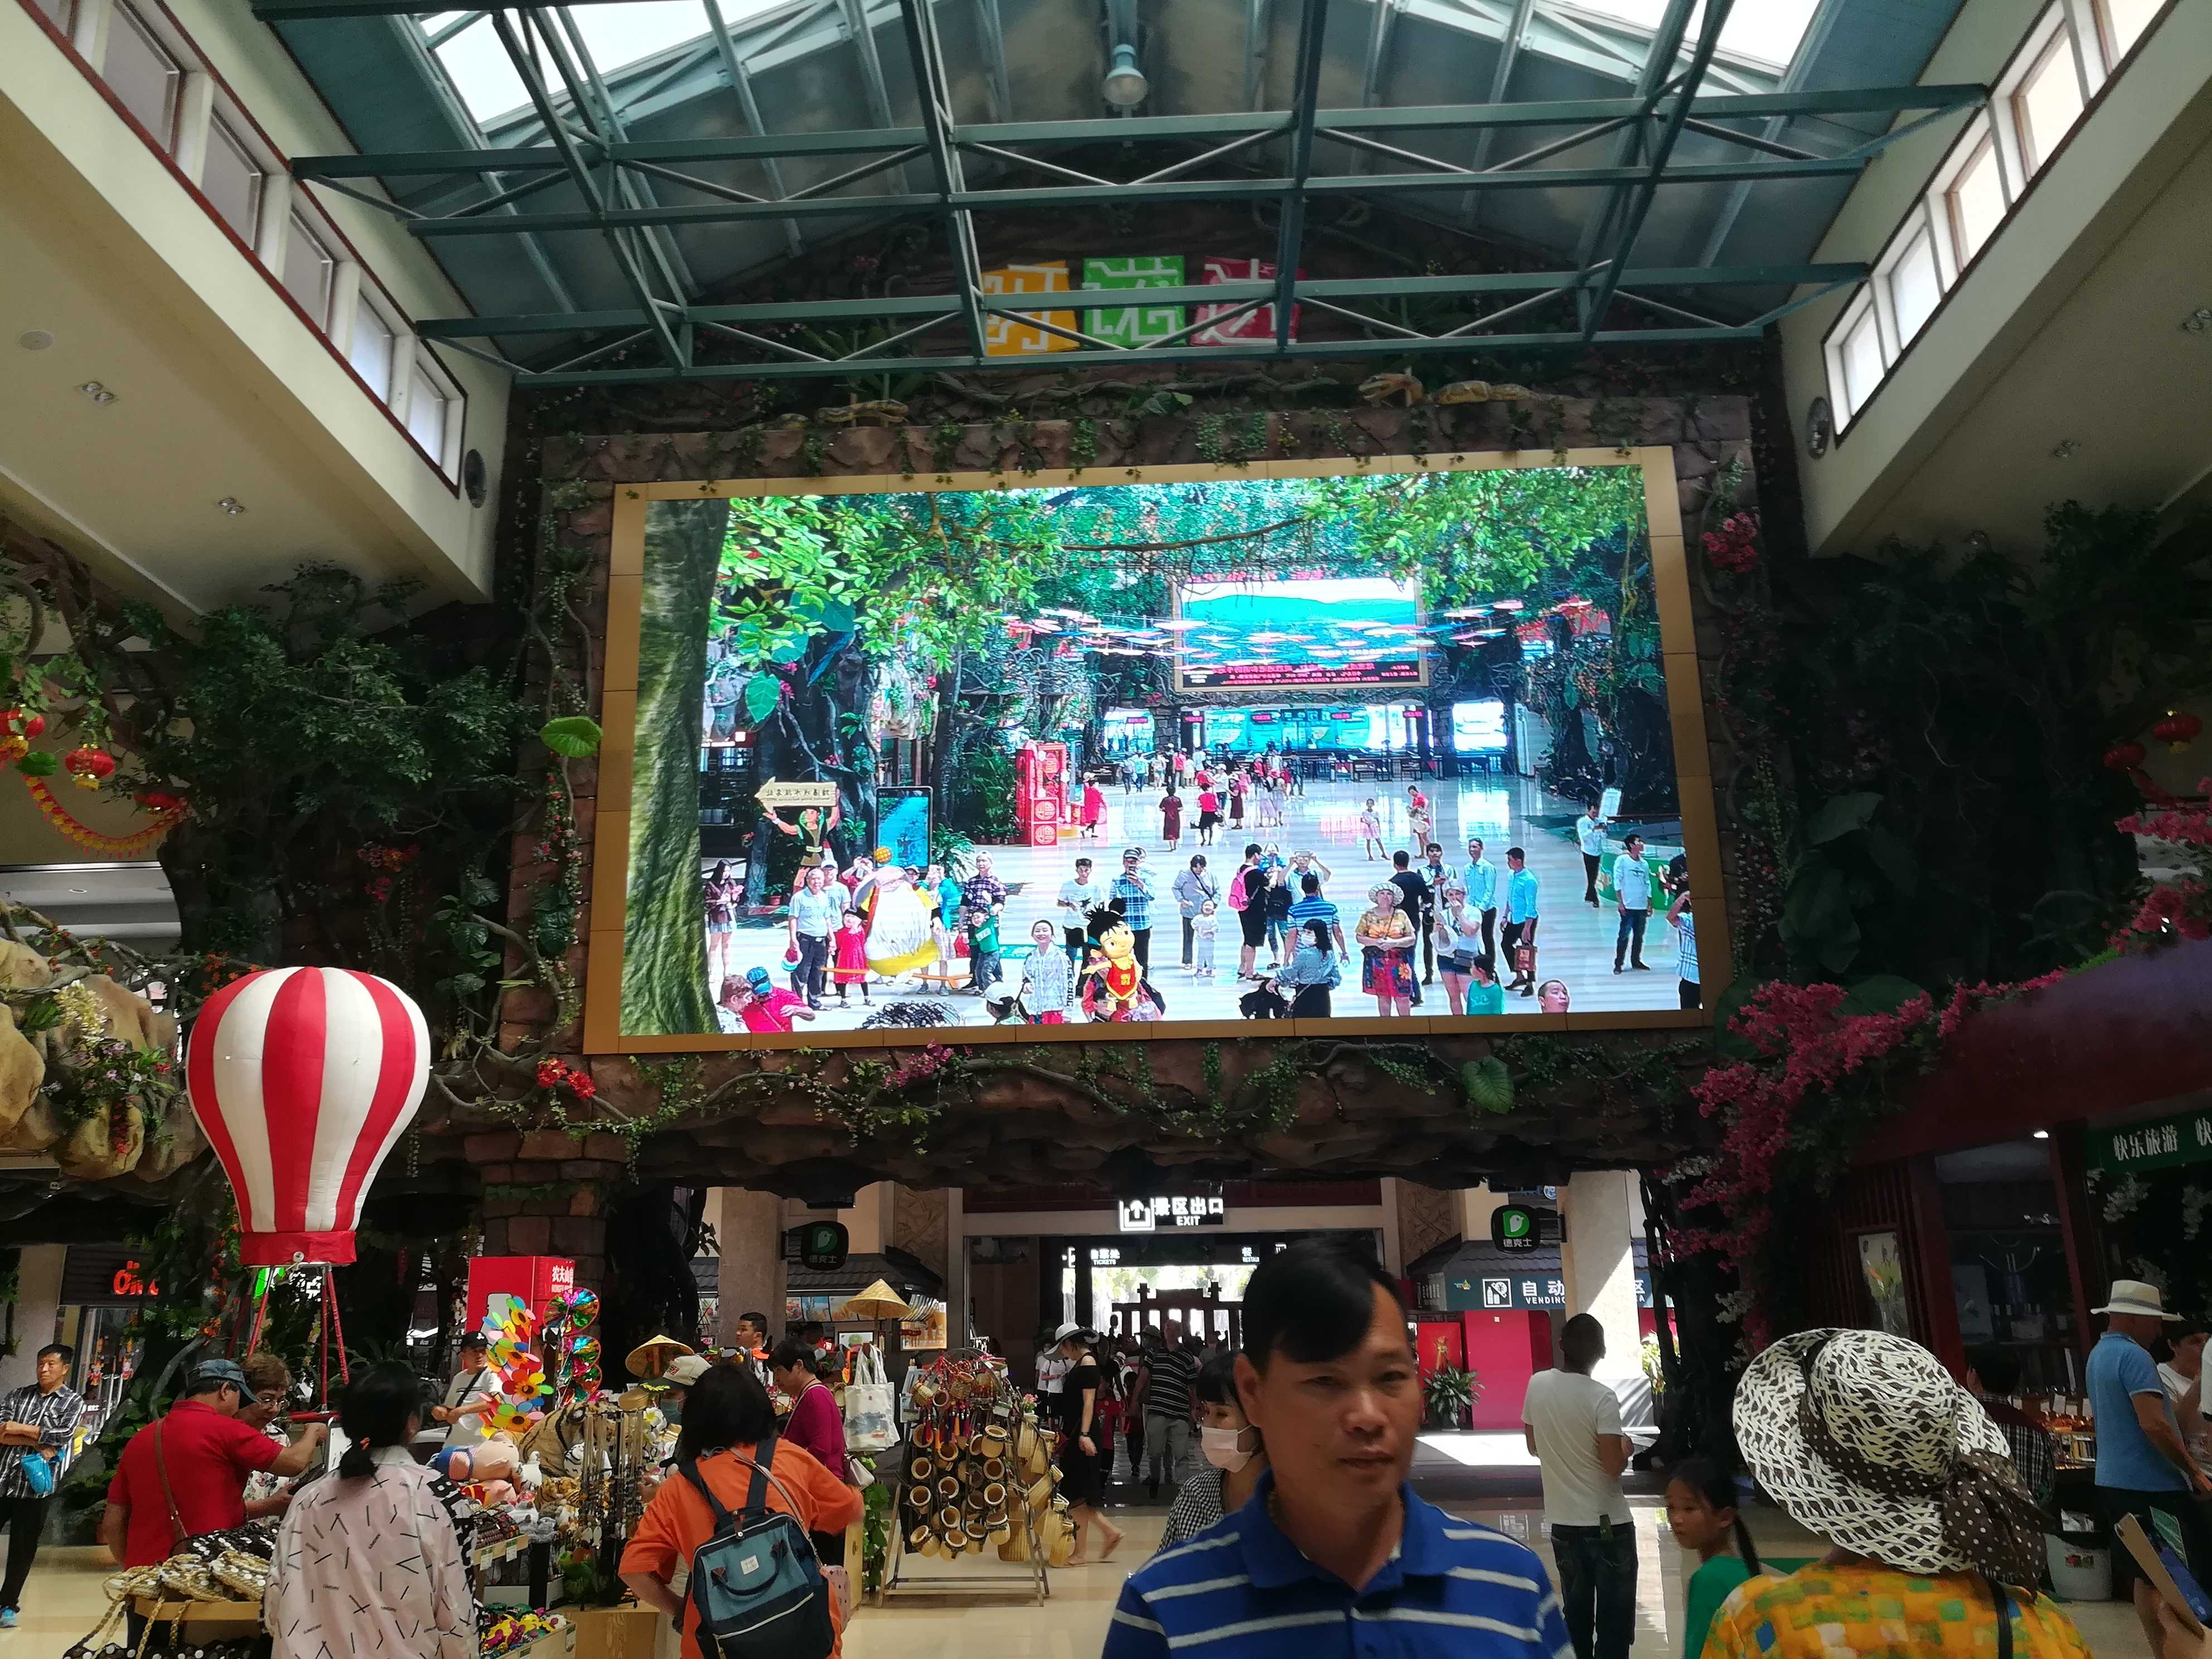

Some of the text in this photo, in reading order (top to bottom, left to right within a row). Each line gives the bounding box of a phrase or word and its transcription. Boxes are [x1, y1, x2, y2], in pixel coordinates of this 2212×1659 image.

[1154, 1197, 1224, 1216] 景区出口
[1176, 1216, 1200, 1226] EXIT
[1503, 1238, 1532, 1248] 德克士
